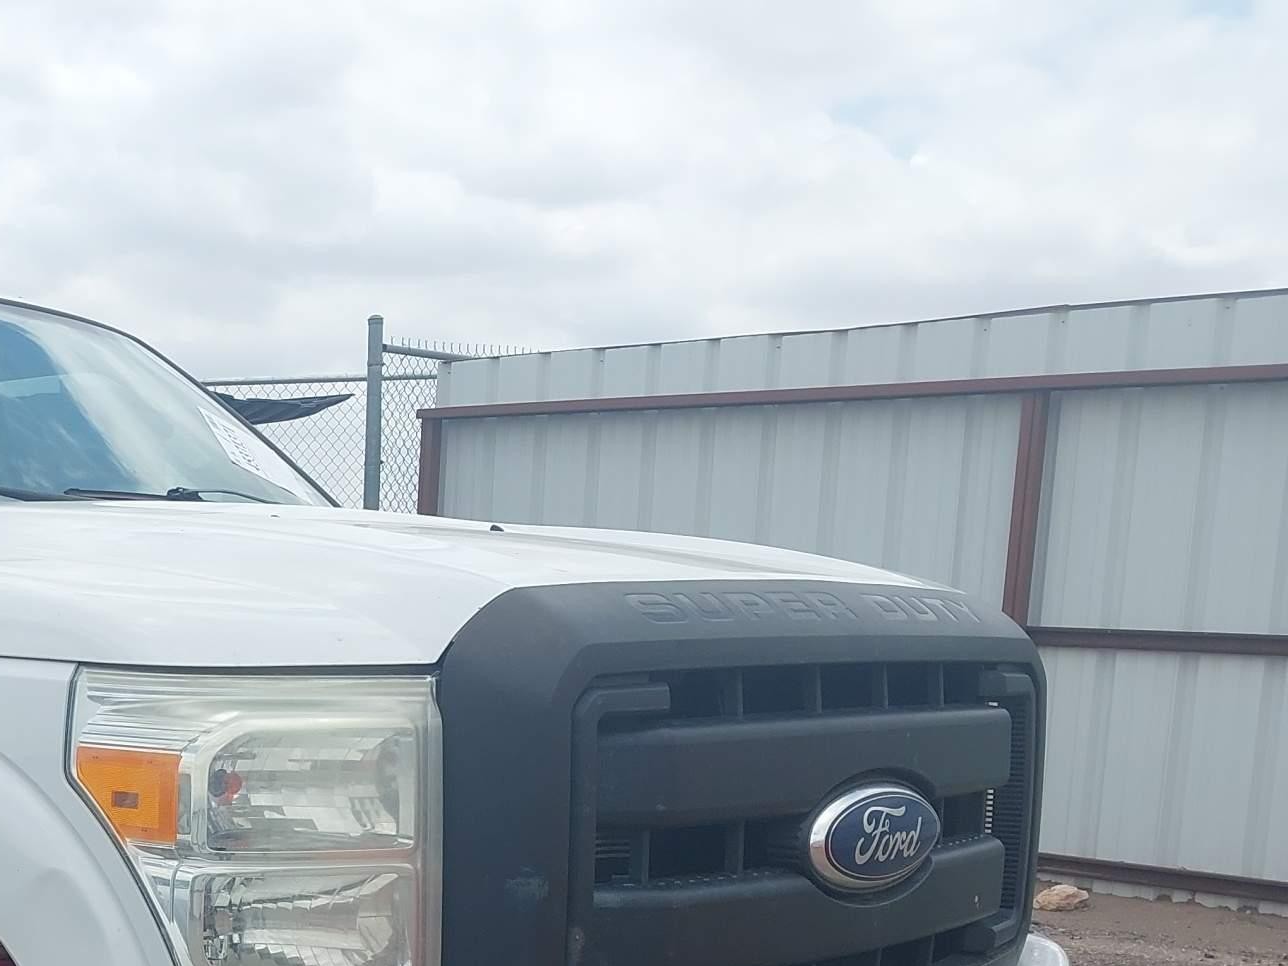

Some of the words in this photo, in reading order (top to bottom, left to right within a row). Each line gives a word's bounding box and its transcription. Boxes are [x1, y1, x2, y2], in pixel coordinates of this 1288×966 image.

[625, 591, 859, 624] SUPER
[863, 594, 983, 623] DUTY
[854, 805, 922, 865] Ford
